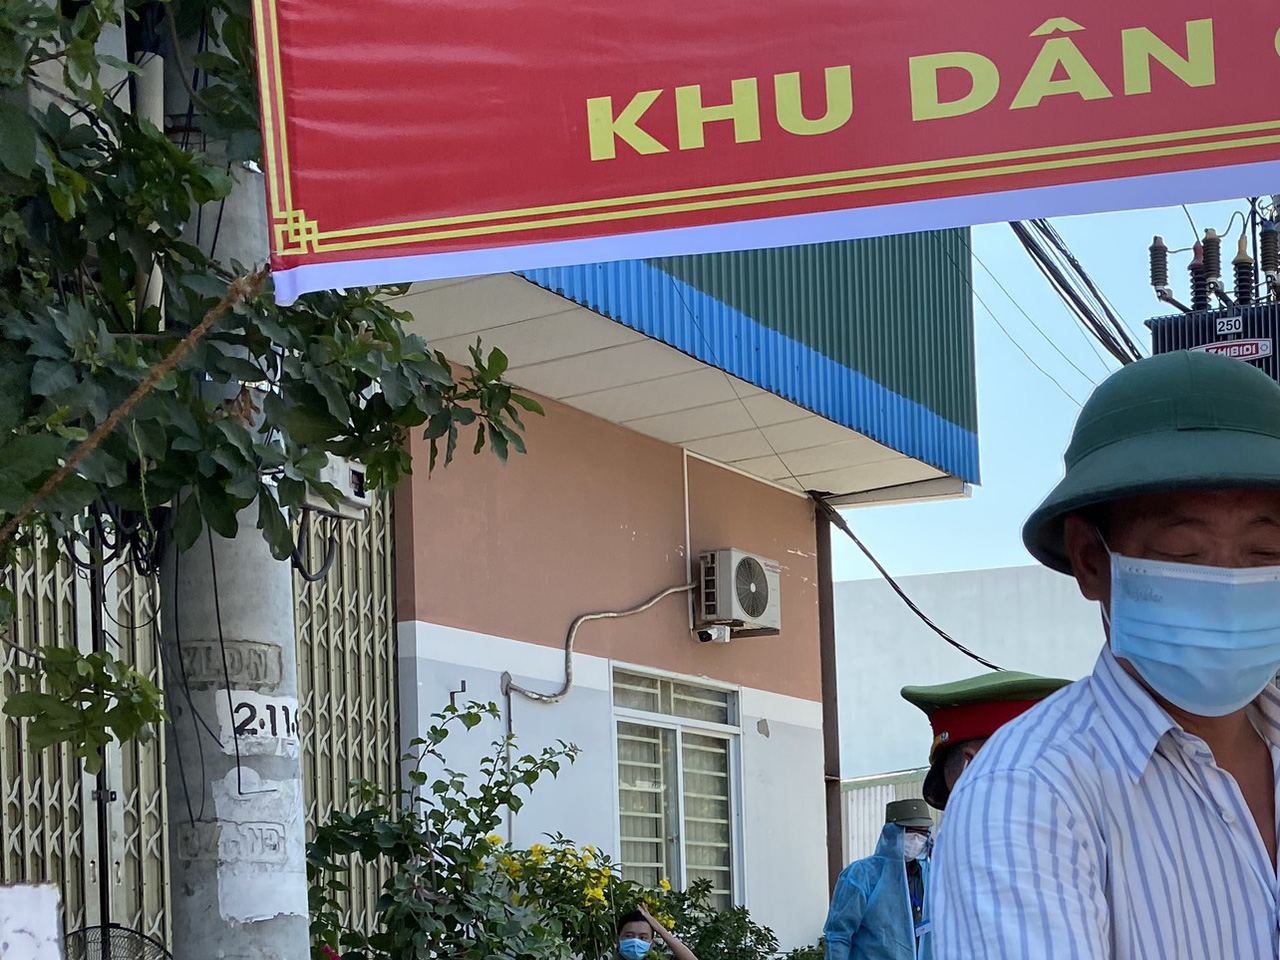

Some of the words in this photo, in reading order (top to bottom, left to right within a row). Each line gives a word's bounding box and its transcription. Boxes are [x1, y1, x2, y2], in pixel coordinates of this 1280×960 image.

[586, 65, 853, 161] KHU
[908, 17, 1215, 121] DÂN
[1217, 319, 1241, 332] 250
